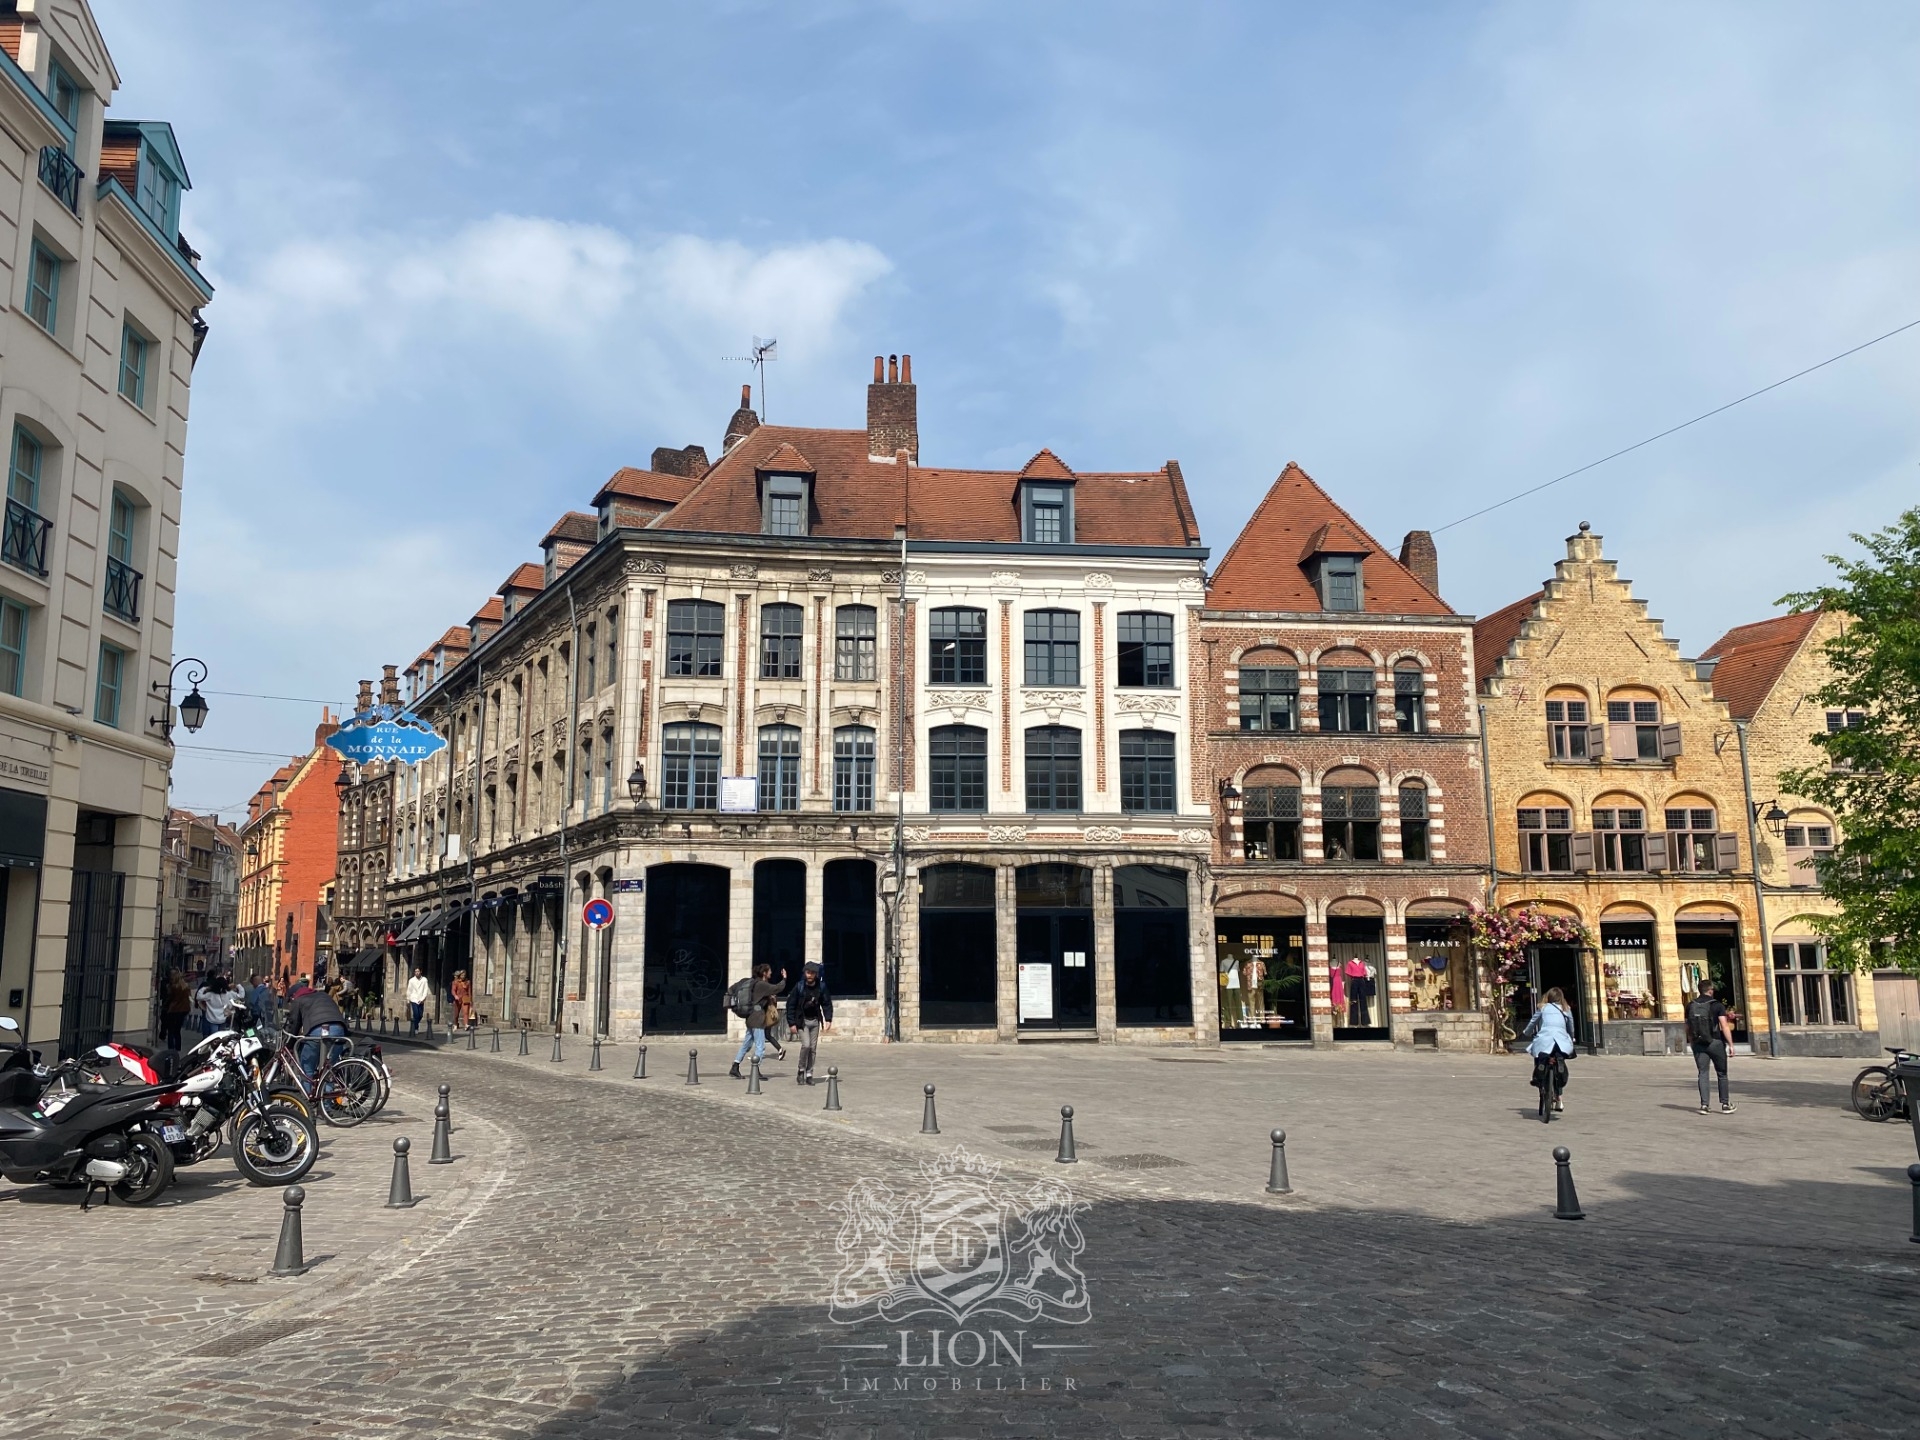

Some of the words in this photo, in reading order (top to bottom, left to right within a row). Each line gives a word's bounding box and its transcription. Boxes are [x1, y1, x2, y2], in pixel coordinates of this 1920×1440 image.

[371, 736, 383, 744] de
[391, 736, 402, 744] la
[347, 745, 427, 754] MONNAIE
[9, 764, 19, 774] LA
[20, 766, 48, 780] TREILLE
[539, 881, 564, 889] ba&sh
[1419, 938, 1461, 947] SÉZANE
[1607, 937, 1648, 946] SÉZANE
